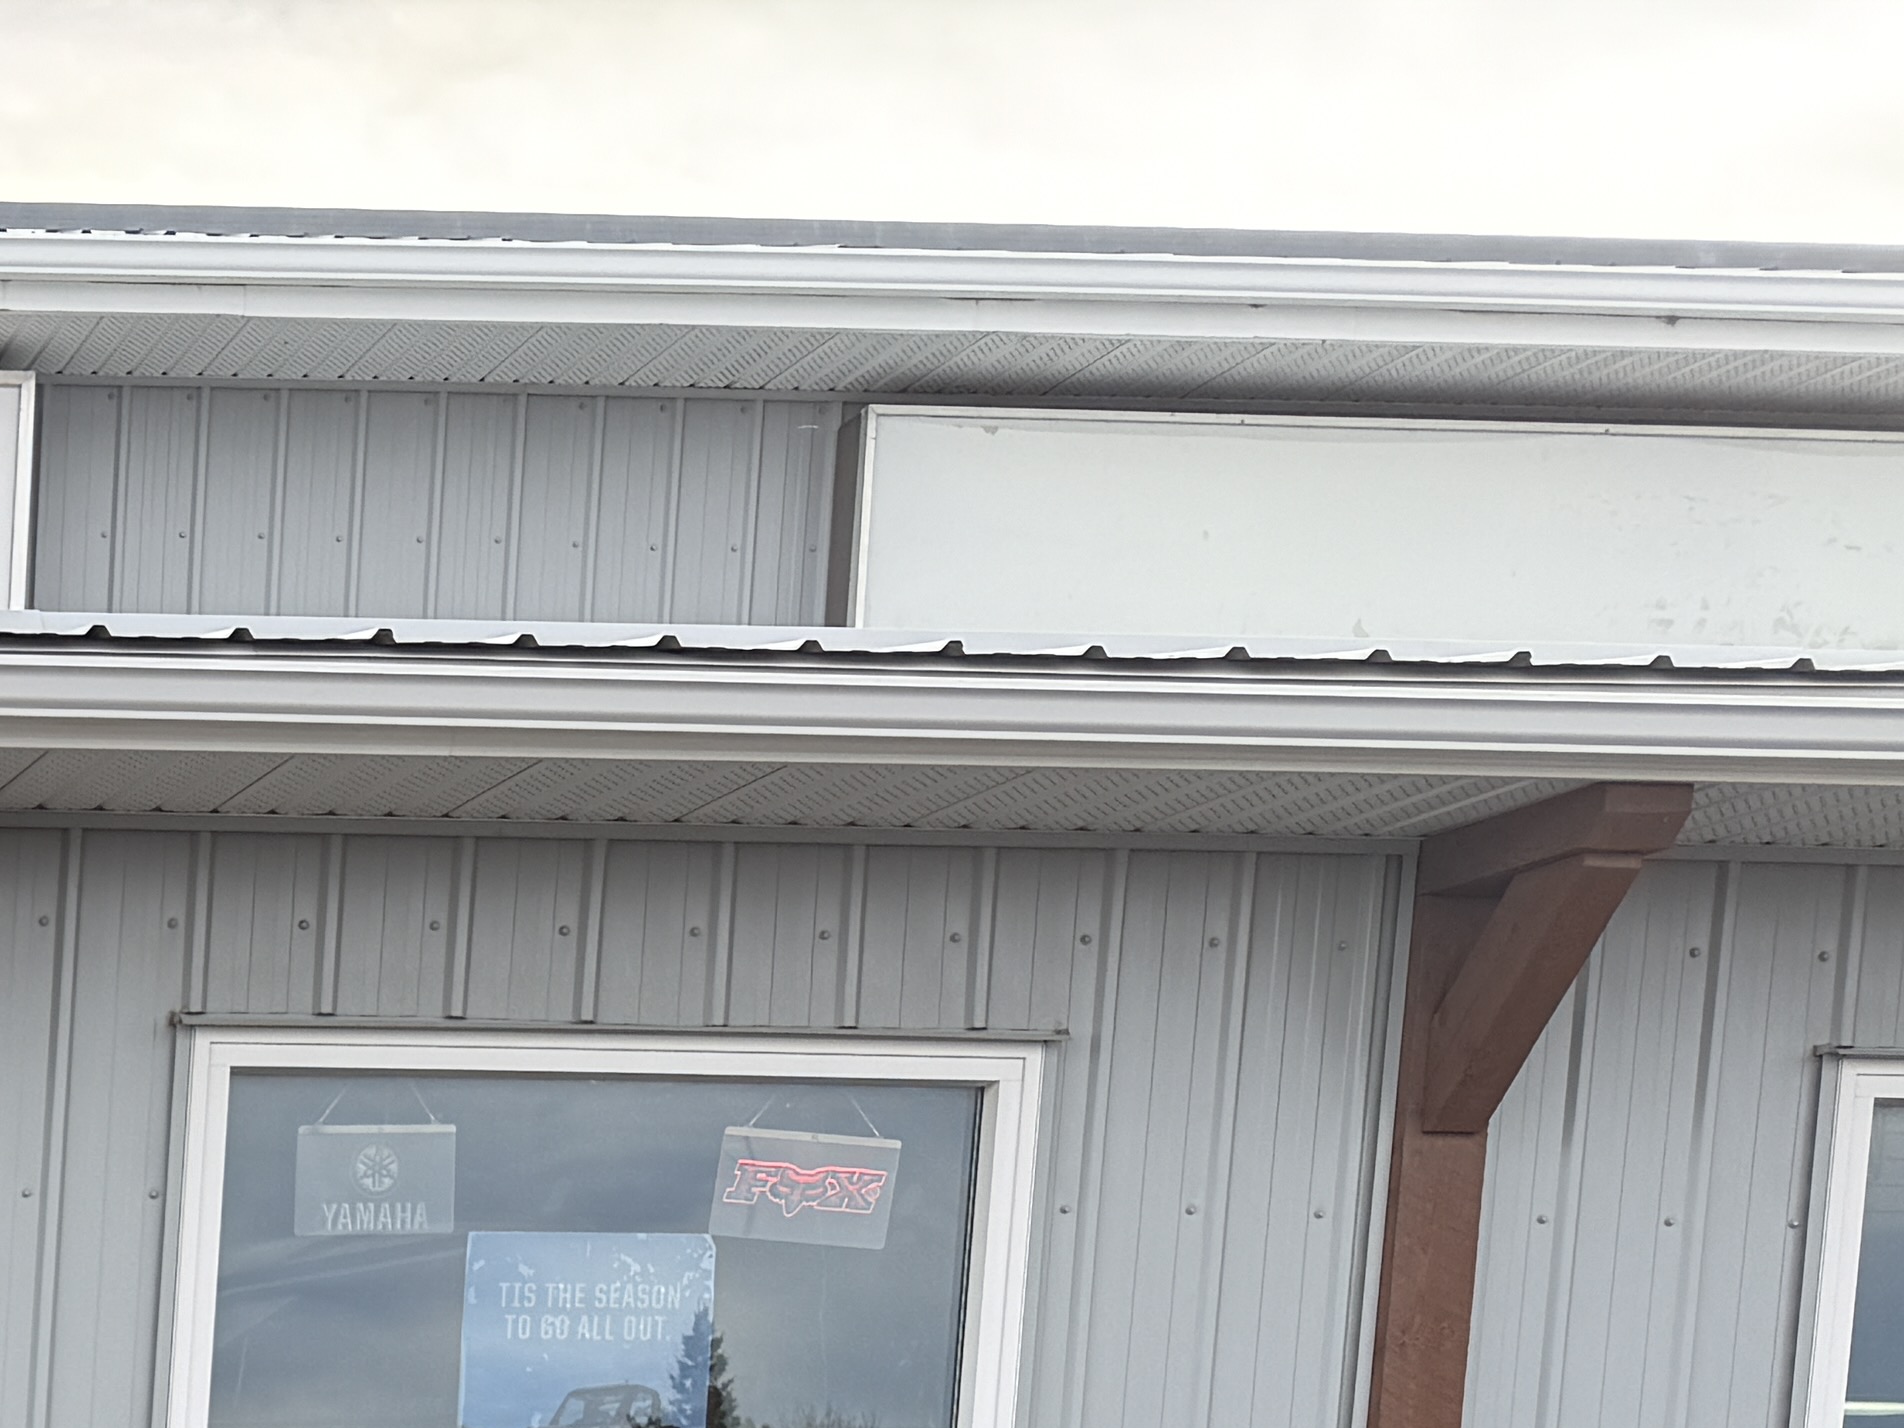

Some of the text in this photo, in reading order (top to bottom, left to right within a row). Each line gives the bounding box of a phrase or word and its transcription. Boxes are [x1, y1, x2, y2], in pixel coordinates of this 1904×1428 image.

[323, 1202, 429, 1231] YAMAHA
[499, 1282, 682, 1309] TIS THE SEASON
[505, 1315, 530, 1339] TO
[541, 1314, 570, 1340] GO
[578, 1315, 614, 1340] ALL
